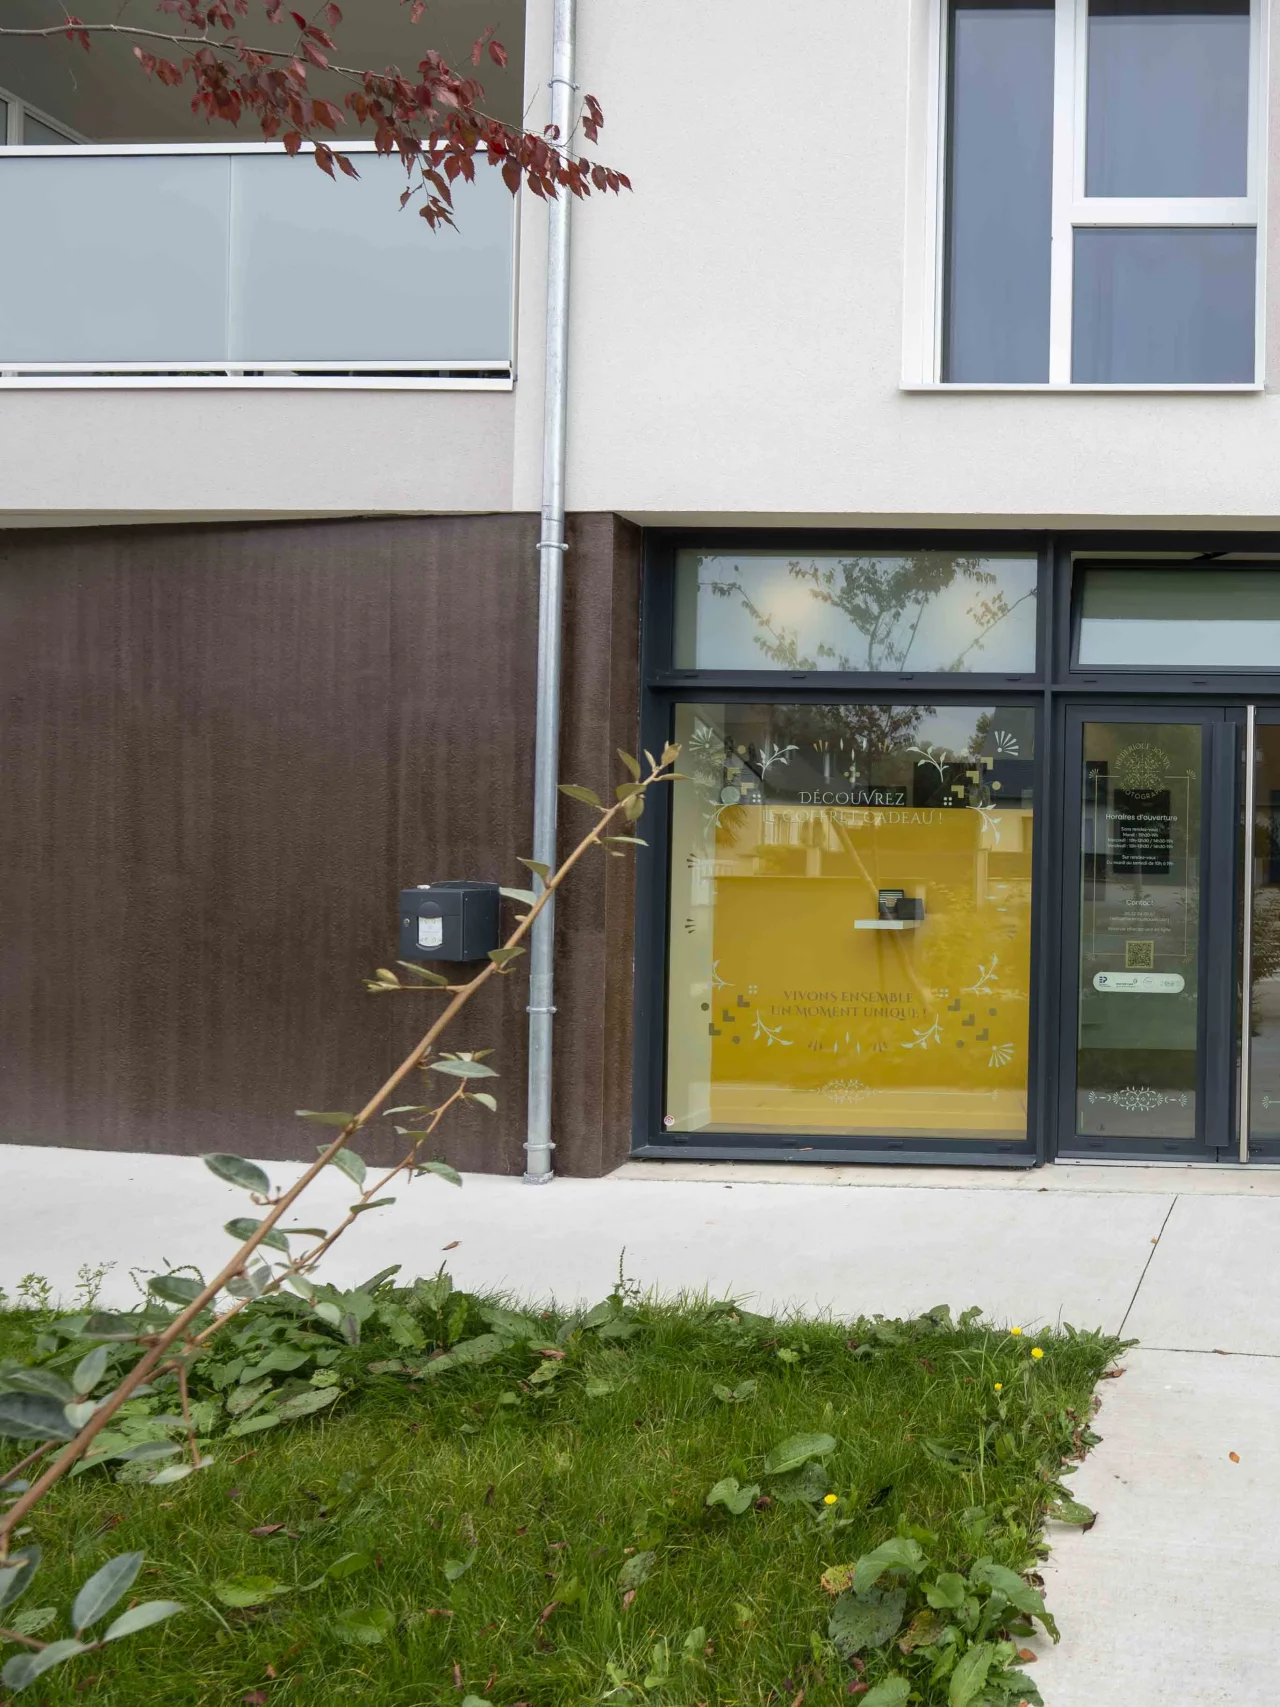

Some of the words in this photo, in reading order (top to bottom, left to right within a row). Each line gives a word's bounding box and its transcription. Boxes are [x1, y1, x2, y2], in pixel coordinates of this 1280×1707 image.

[797, 789, 905, 806] DÉCOUVREZ
[762, 809, 775, 822] LE
[782, 809, 857, 826] COFFRET
[863, 809, 935, 825] CADEAU
[1105, 813, 1136, 821] Horaires
[1136, 814, 1178, 822] d'ouverture
[783, 990, 838, 1003] VIVONS
[841, 991, 913, 1004] ENSEMBLE
[771, 1004, 791, 1016] UN
[794, 1004, 860, 1018] MOMENT
[863, 1007, 919, 1021] UNIQUE
